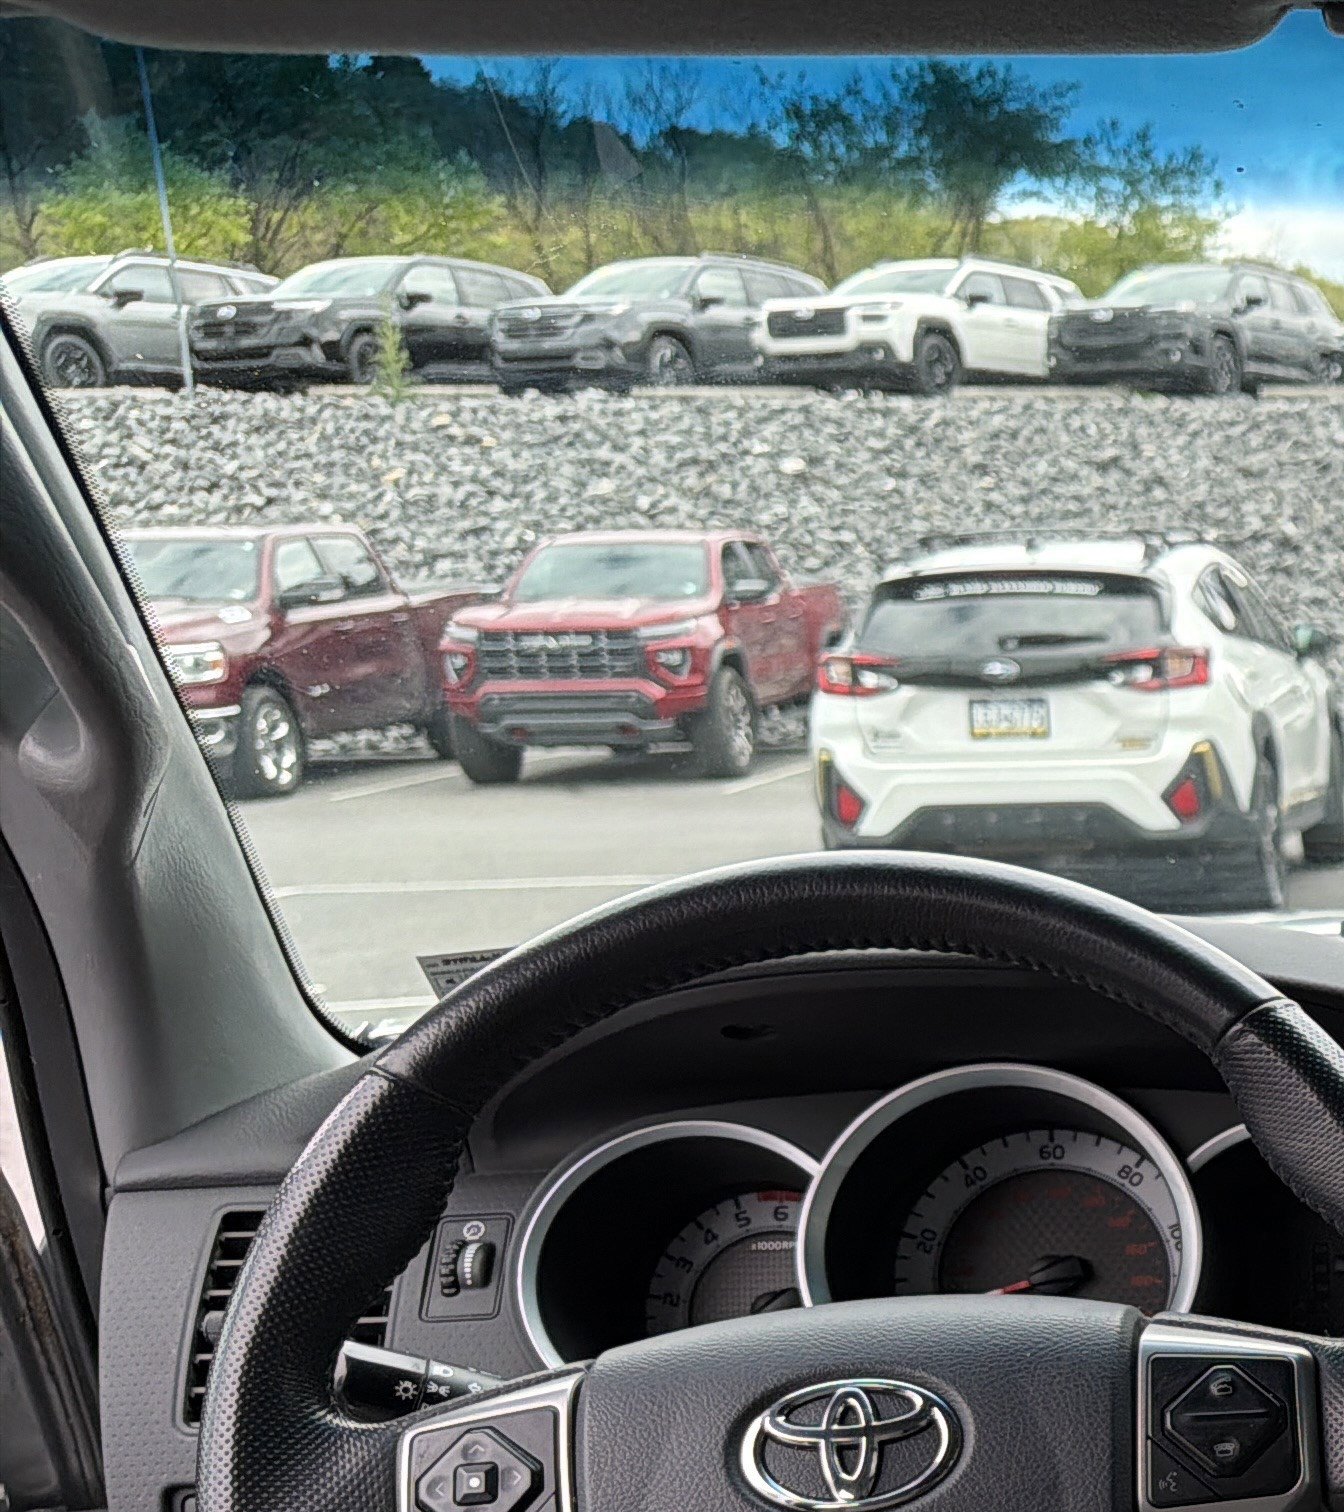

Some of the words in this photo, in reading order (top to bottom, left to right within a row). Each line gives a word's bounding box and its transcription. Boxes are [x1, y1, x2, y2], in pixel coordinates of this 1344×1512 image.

[1039, 1144, 1066, 1160] 60
[1117, 1164, 1144, 1188] 80
[773, 1206, 789, 1222] 6
